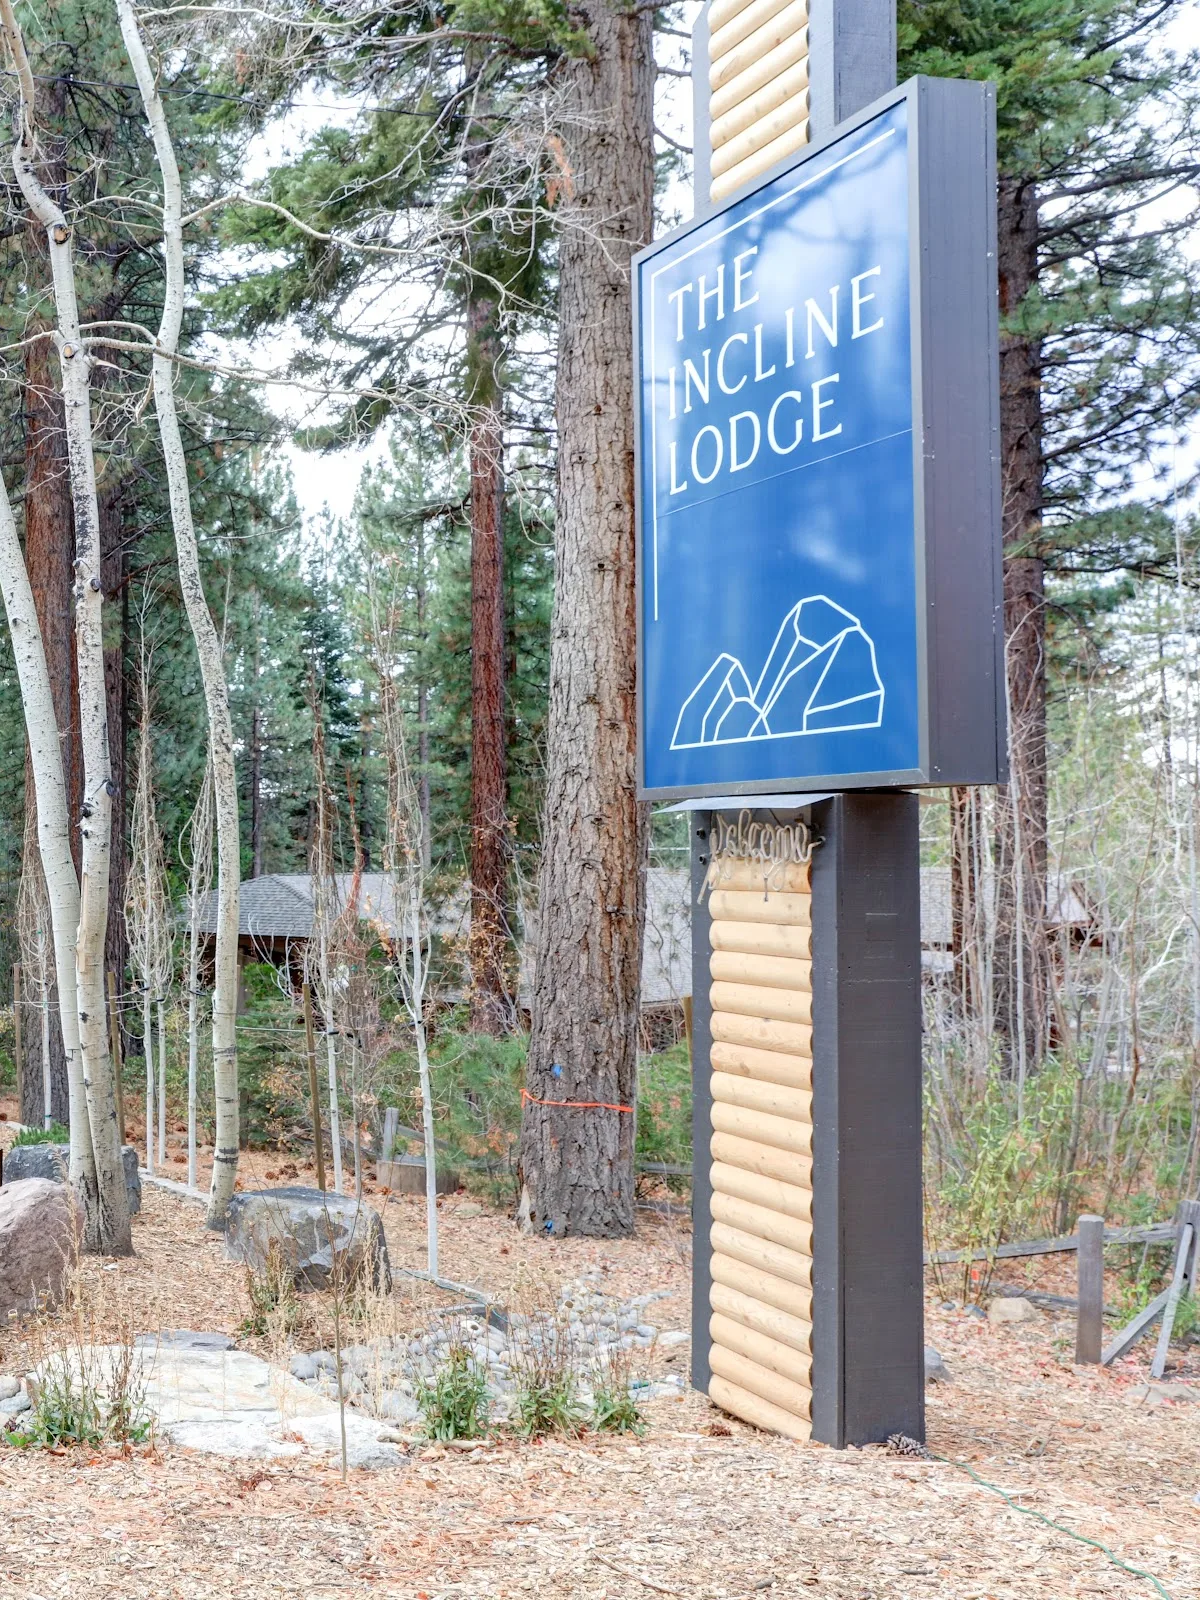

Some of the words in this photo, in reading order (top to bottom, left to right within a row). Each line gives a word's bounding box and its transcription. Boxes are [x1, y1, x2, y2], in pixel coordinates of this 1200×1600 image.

[668, 246, 759, 341] THE
[668, 265, 884, 420] INCLINE
[669, 373, 842, 496] LODGE
